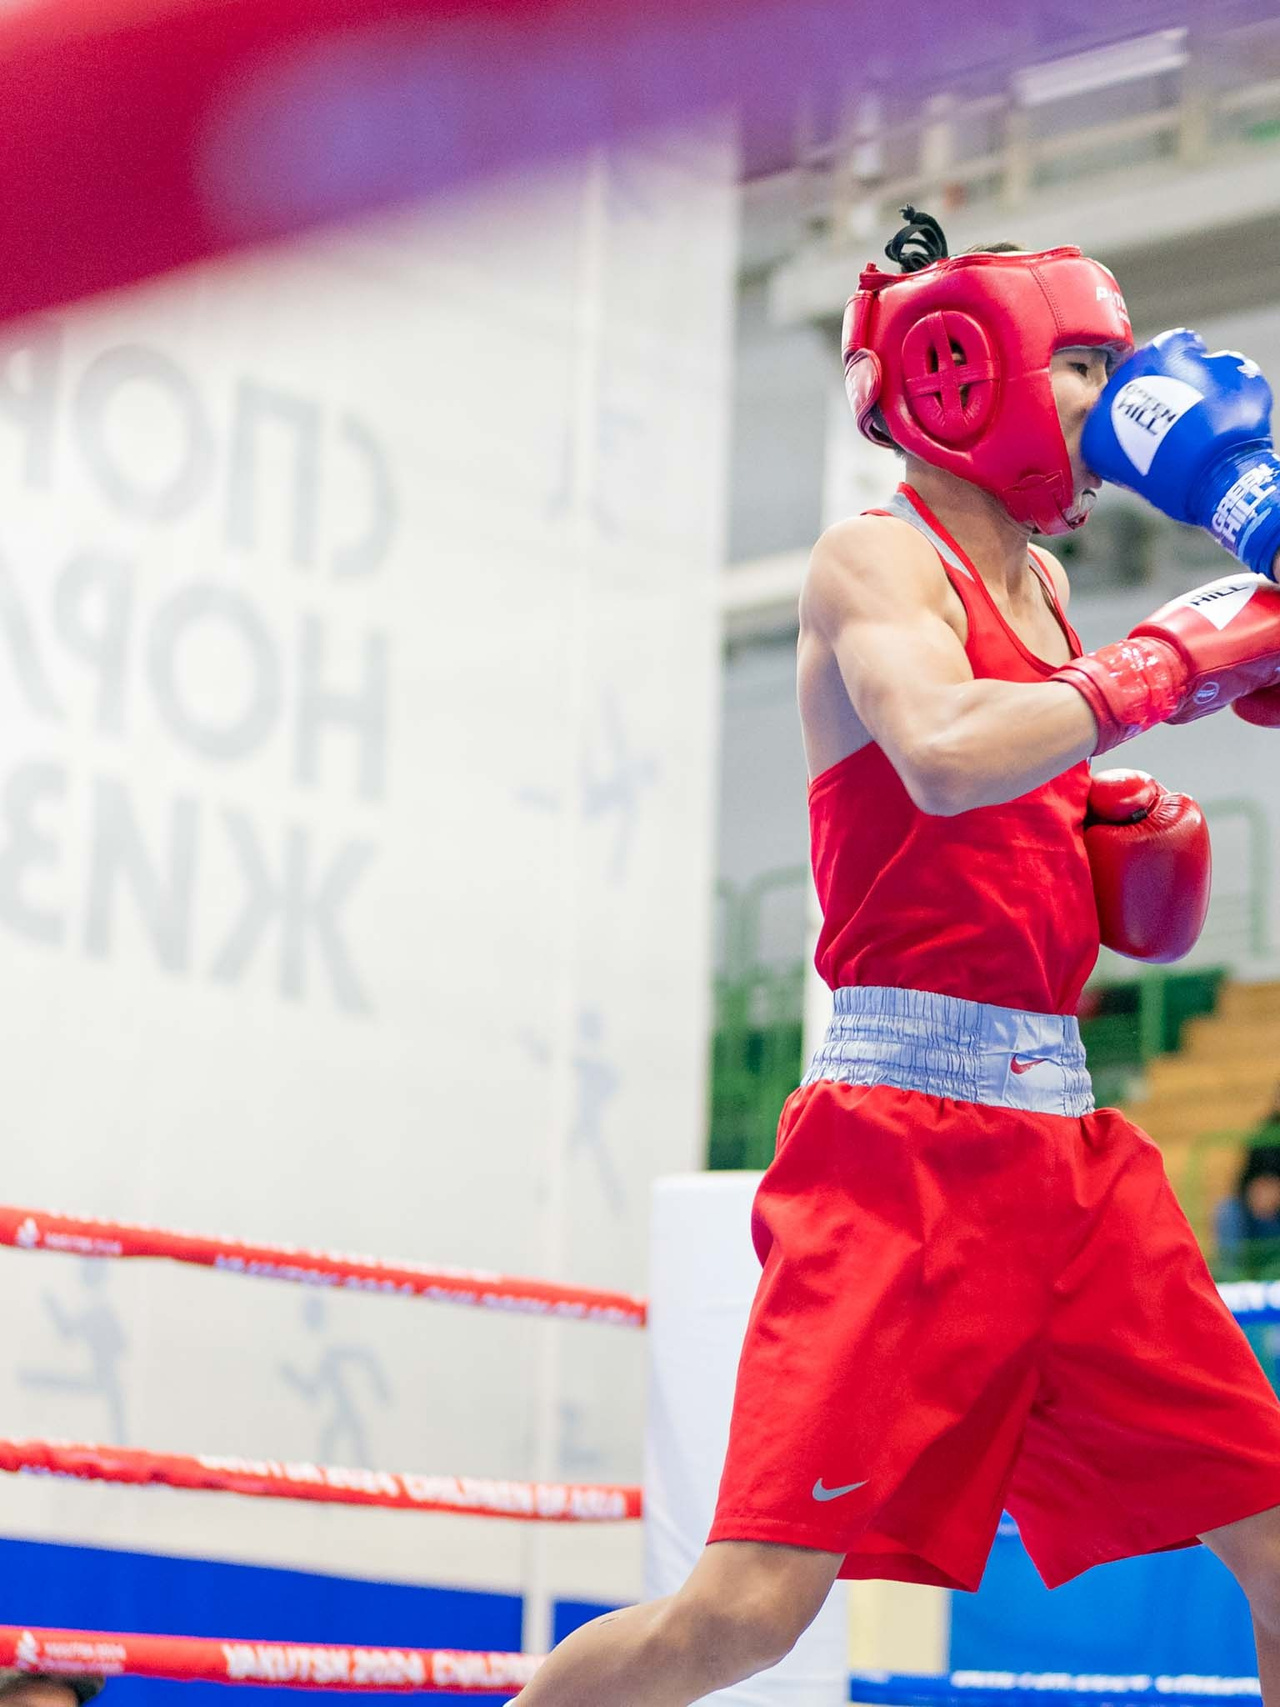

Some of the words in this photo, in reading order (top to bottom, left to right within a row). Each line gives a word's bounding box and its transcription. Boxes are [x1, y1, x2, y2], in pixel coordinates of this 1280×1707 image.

[1210, 462, 1274, 534] GREEN
[1222, 481, 1277, 545] HILL
[1188, 581, 1249, 607] HILL
